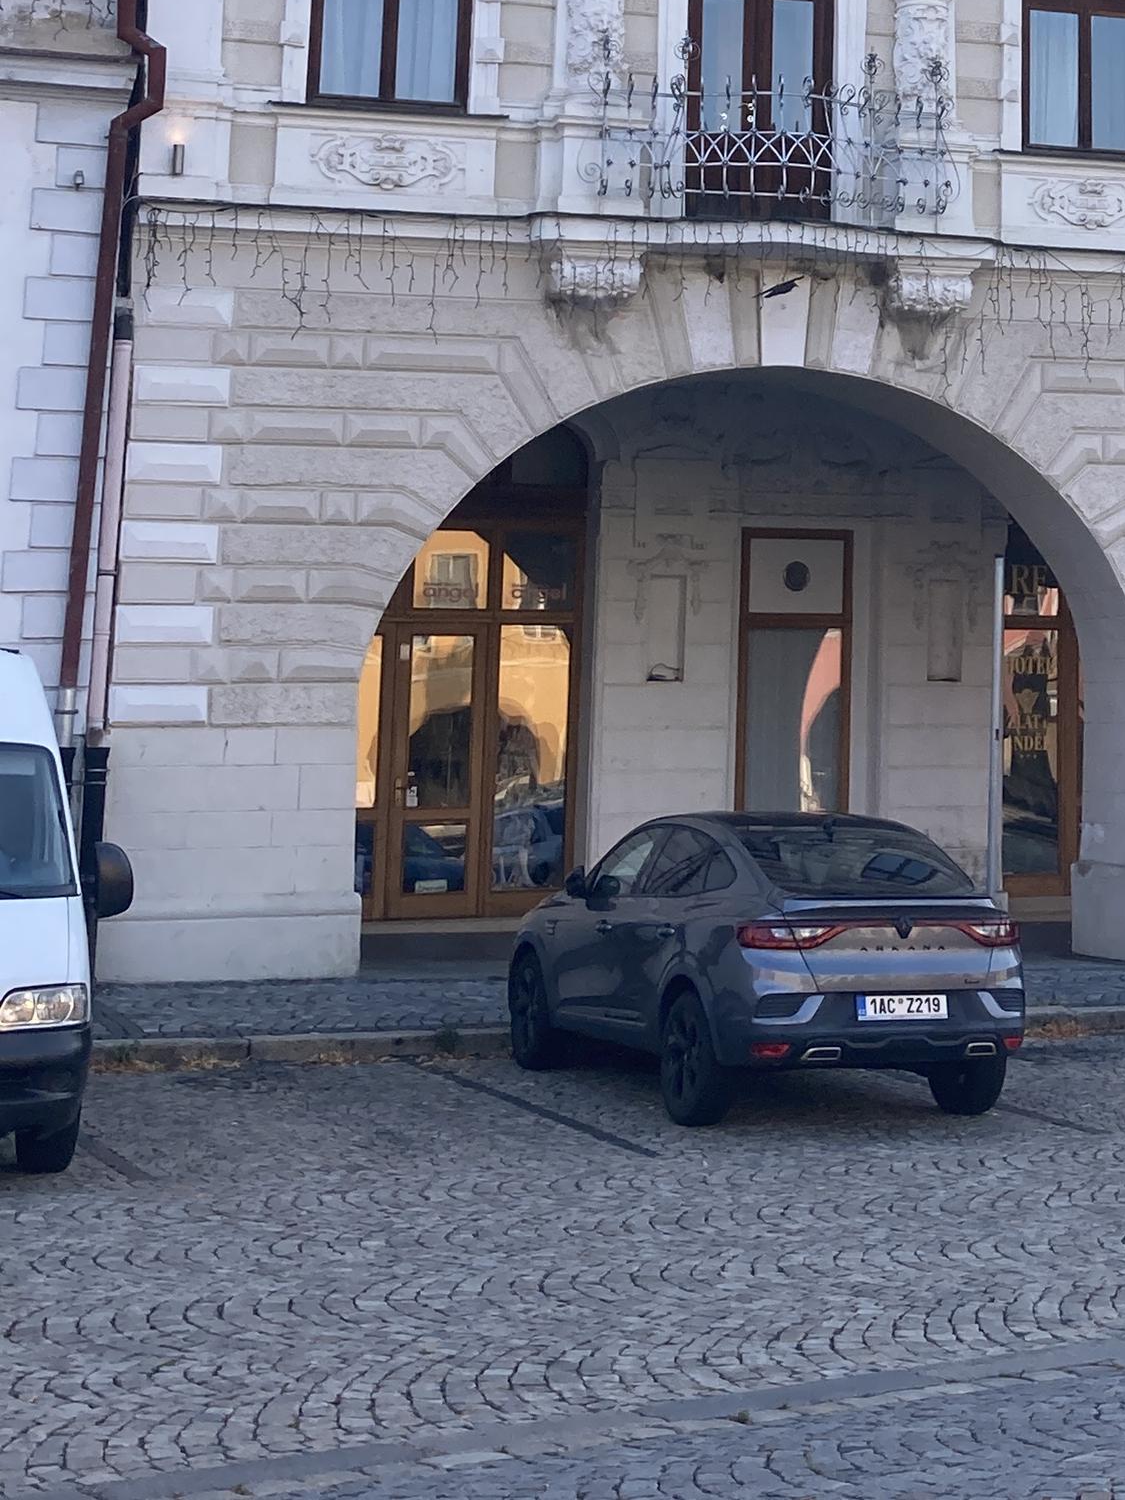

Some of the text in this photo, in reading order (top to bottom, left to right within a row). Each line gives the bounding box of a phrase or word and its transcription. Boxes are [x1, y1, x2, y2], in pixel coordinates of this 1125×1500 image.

[422, 581, 479, 602] angel
[870, 998, 896, 1014] 1AC
[906, 997, 941, 1013] Z219
